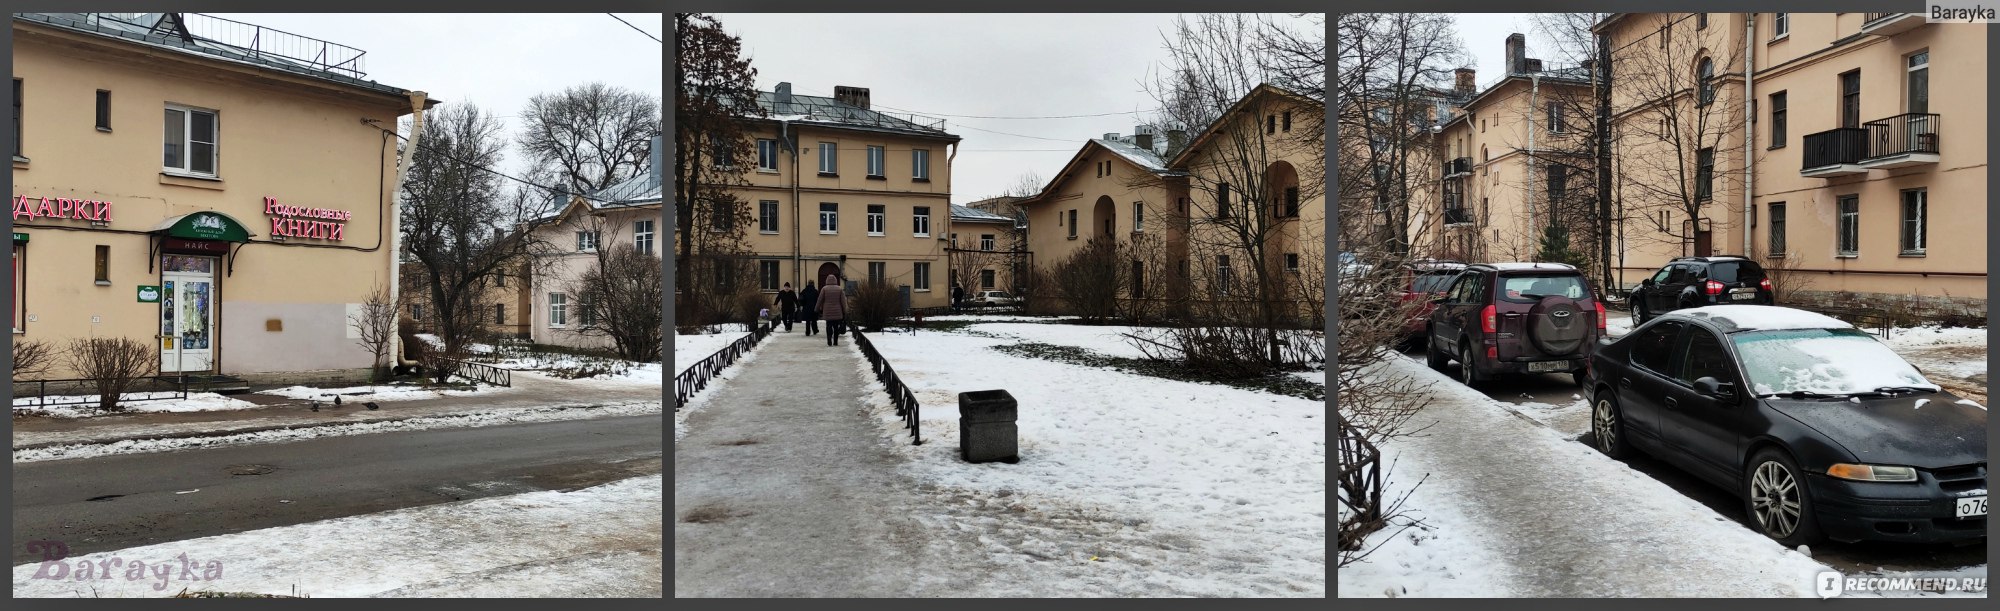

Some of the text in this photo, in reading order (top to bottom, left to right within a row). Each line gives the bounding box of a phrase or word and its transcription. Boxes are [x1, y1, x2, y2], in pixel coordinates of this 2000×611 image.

[12, 195, 113, 221] ДАРКИ
[271, 217, 344, 241] КНИГИ
[185, 242, 209, 250] НАЙС
